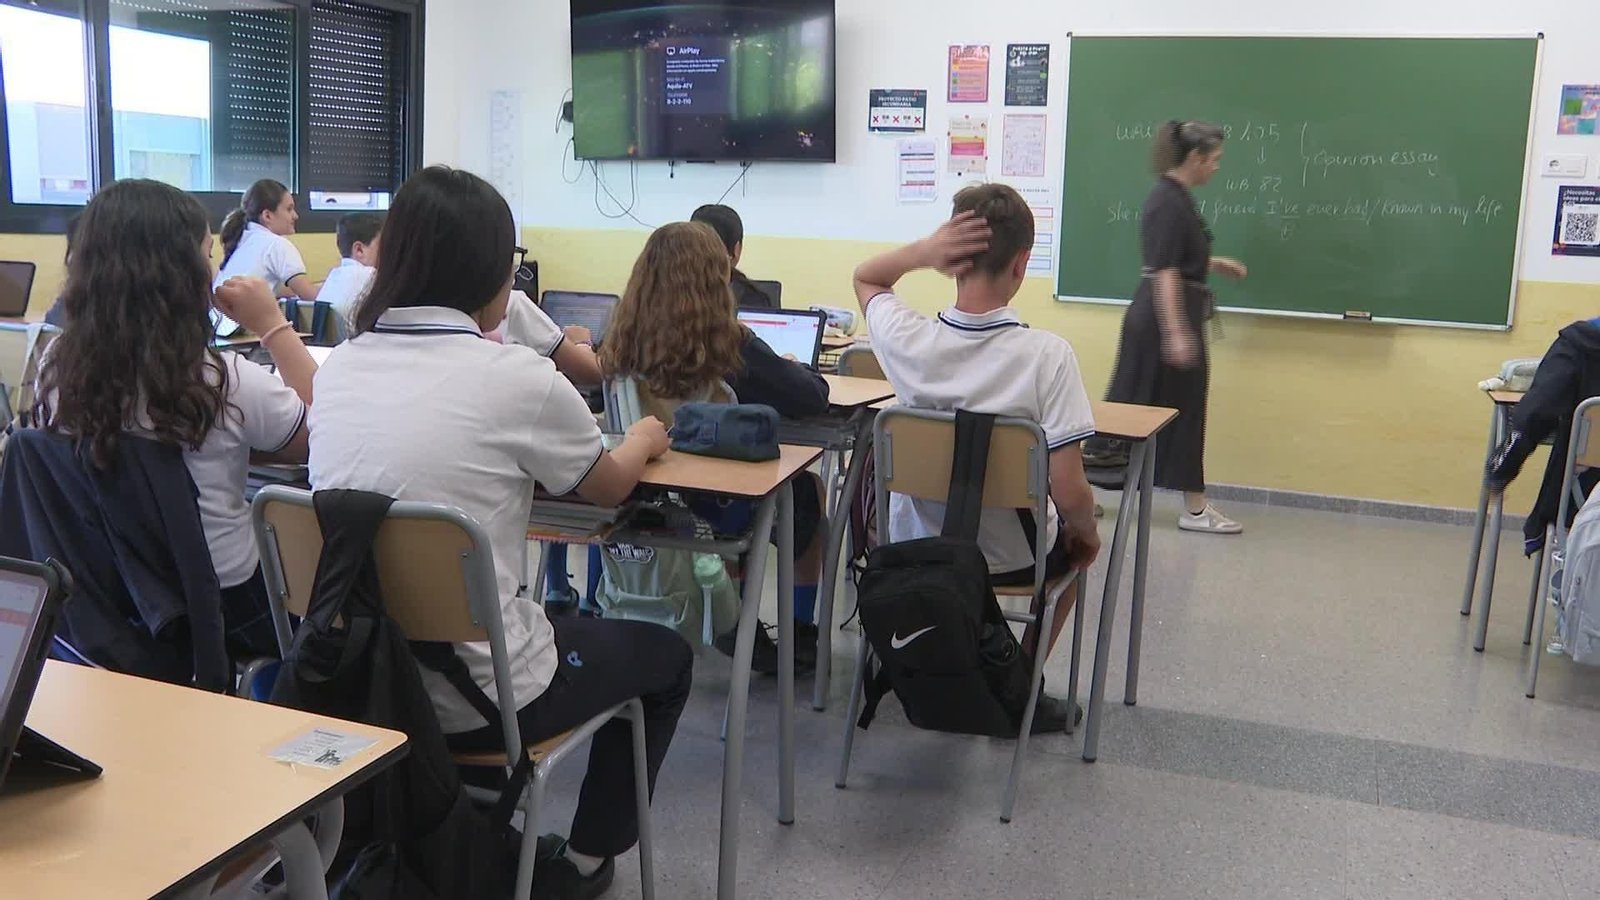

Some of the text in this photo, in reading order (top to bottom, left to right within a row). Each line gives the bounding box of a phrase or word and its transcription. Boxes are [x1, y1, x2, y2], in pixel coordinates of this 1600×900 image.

[679, 47, 700, 55] AirPlay
[1390, 151, 1439, 176] essay
[1449, 205, 1468, 225] my
[1475, 194, 1503, 223] life
